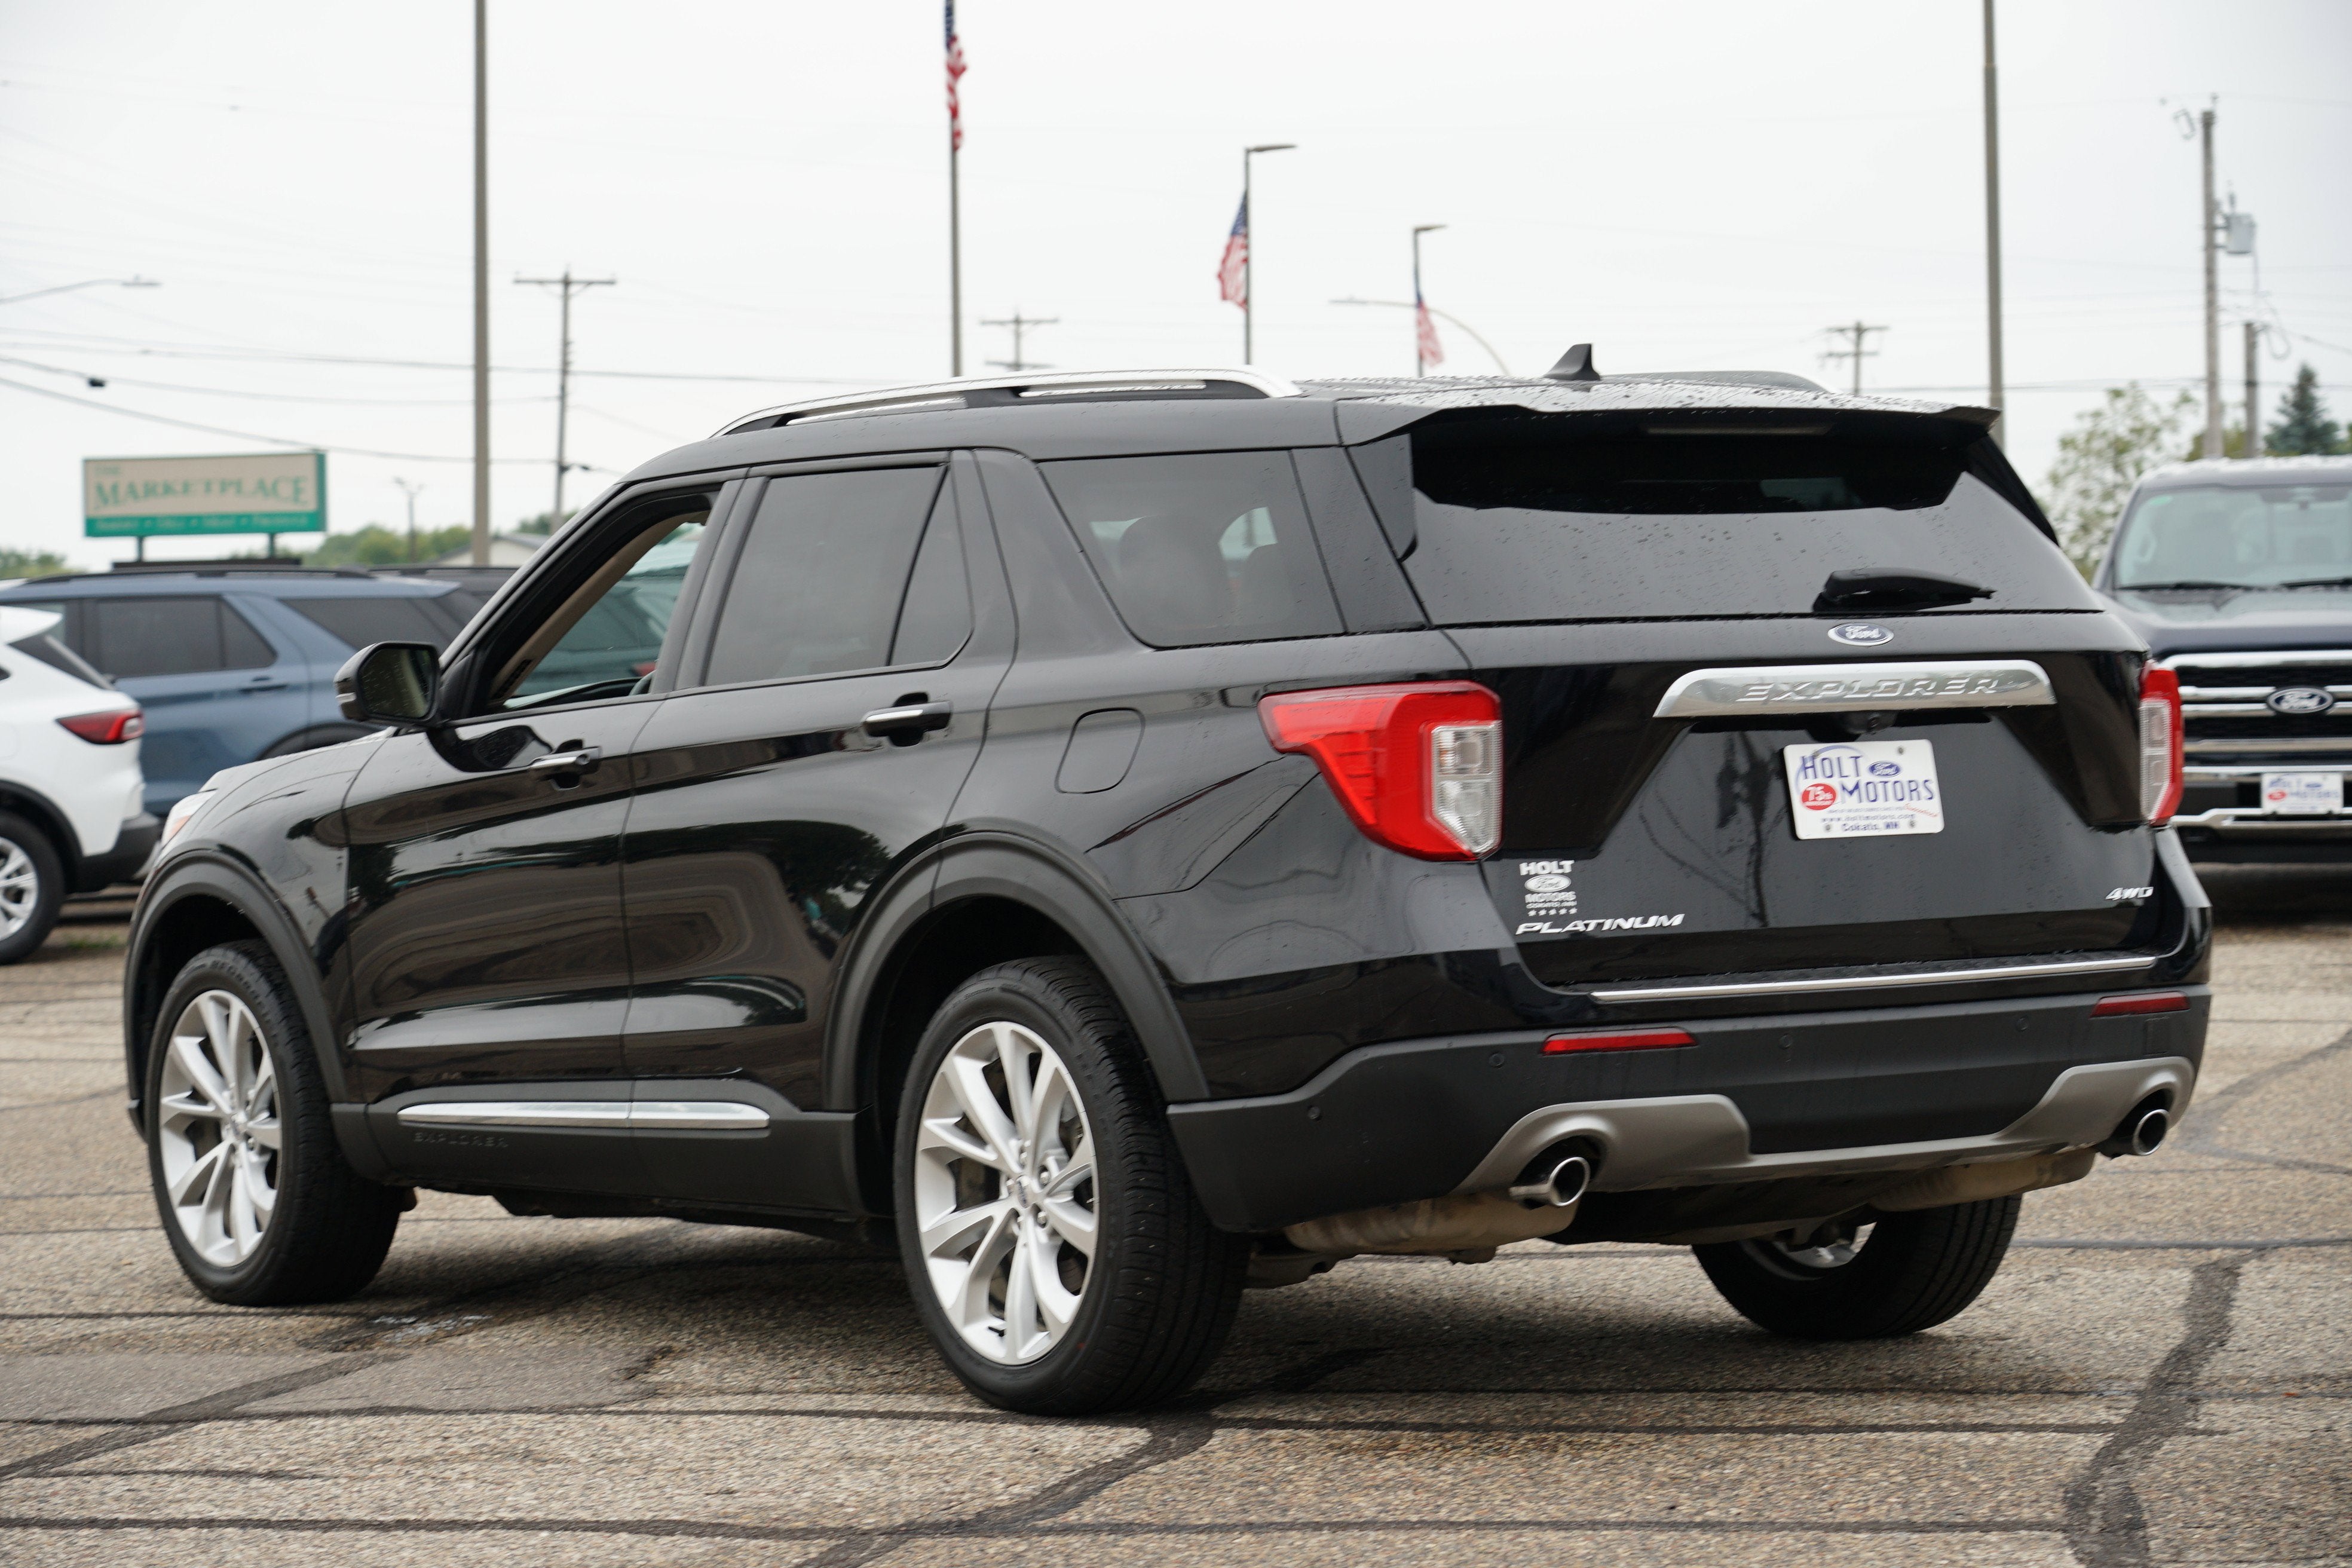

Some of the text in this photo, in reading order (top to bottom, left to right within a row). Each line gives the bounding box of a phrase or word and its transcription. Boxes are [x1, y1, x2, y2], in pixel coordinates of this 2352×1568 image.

[93, 476, 310, 509] MARKETPLACE
[1845, 624, 1882, 639] Ford
[1735, 677, 2002, 703] EXPLORER
[1801, 755, 1863, 779] HOLT
[1841, 779, 1934, 804] MOTORS
[1520, 860, 1575, 875] HOLT
[1525, 891, 1576, 903] MOTORS
[2105, 887, 2154, 901] 4WD
[1515, 913, 1685, 935] PLATINUM
